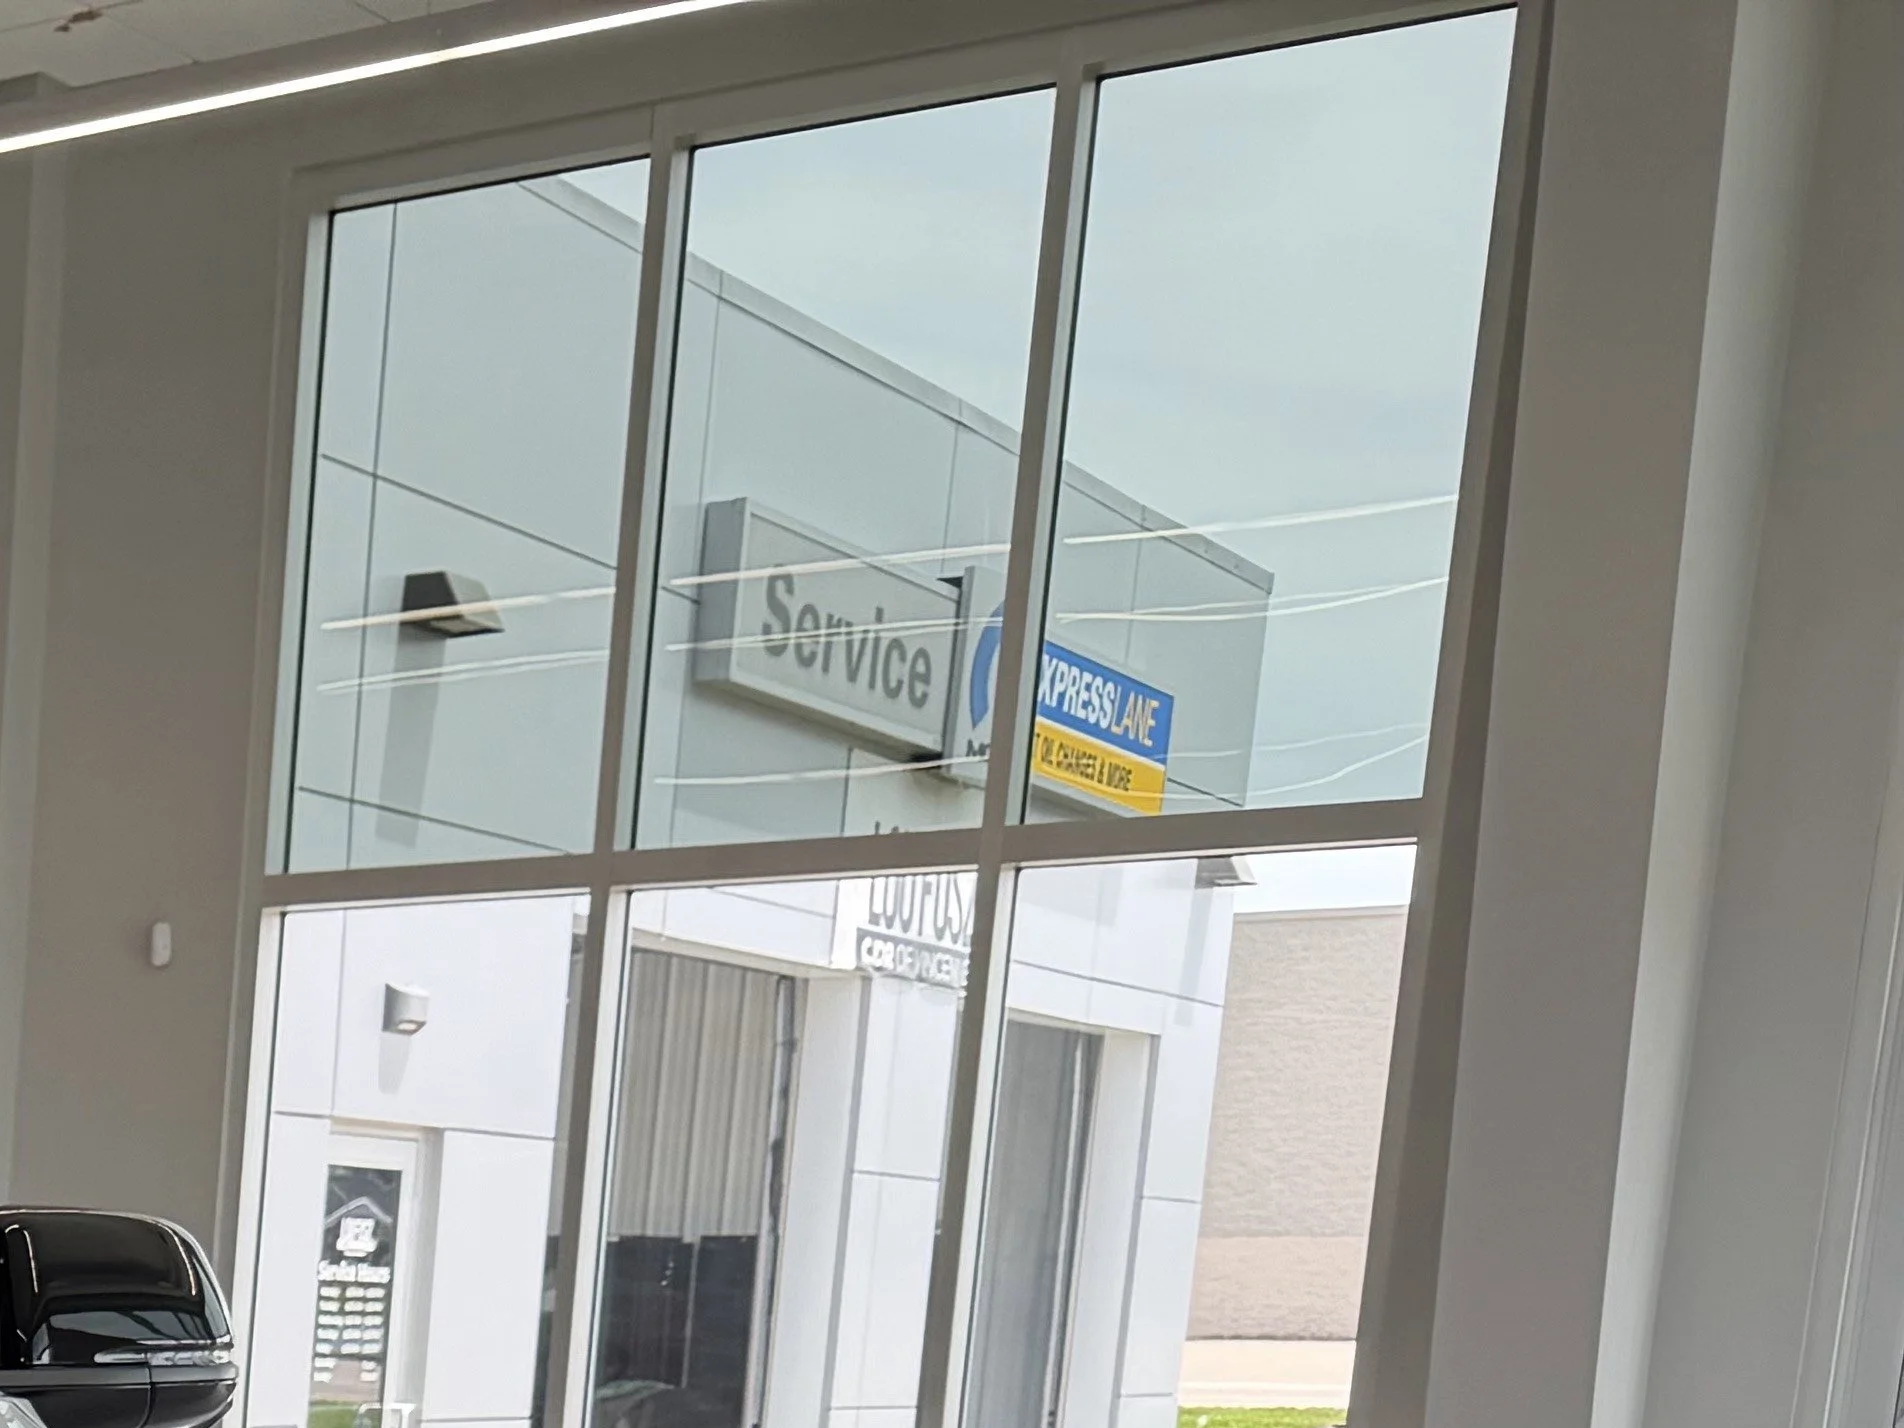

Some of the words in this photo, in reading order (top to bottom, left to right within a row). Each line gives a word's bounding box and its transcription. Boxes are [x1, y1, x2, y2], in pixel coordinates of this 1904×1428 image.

[761, 563, 932, 709] Service
[1038, 653, 1160, 748] XPRESSLANE
[1106, 761, 1133, 792] MORE
